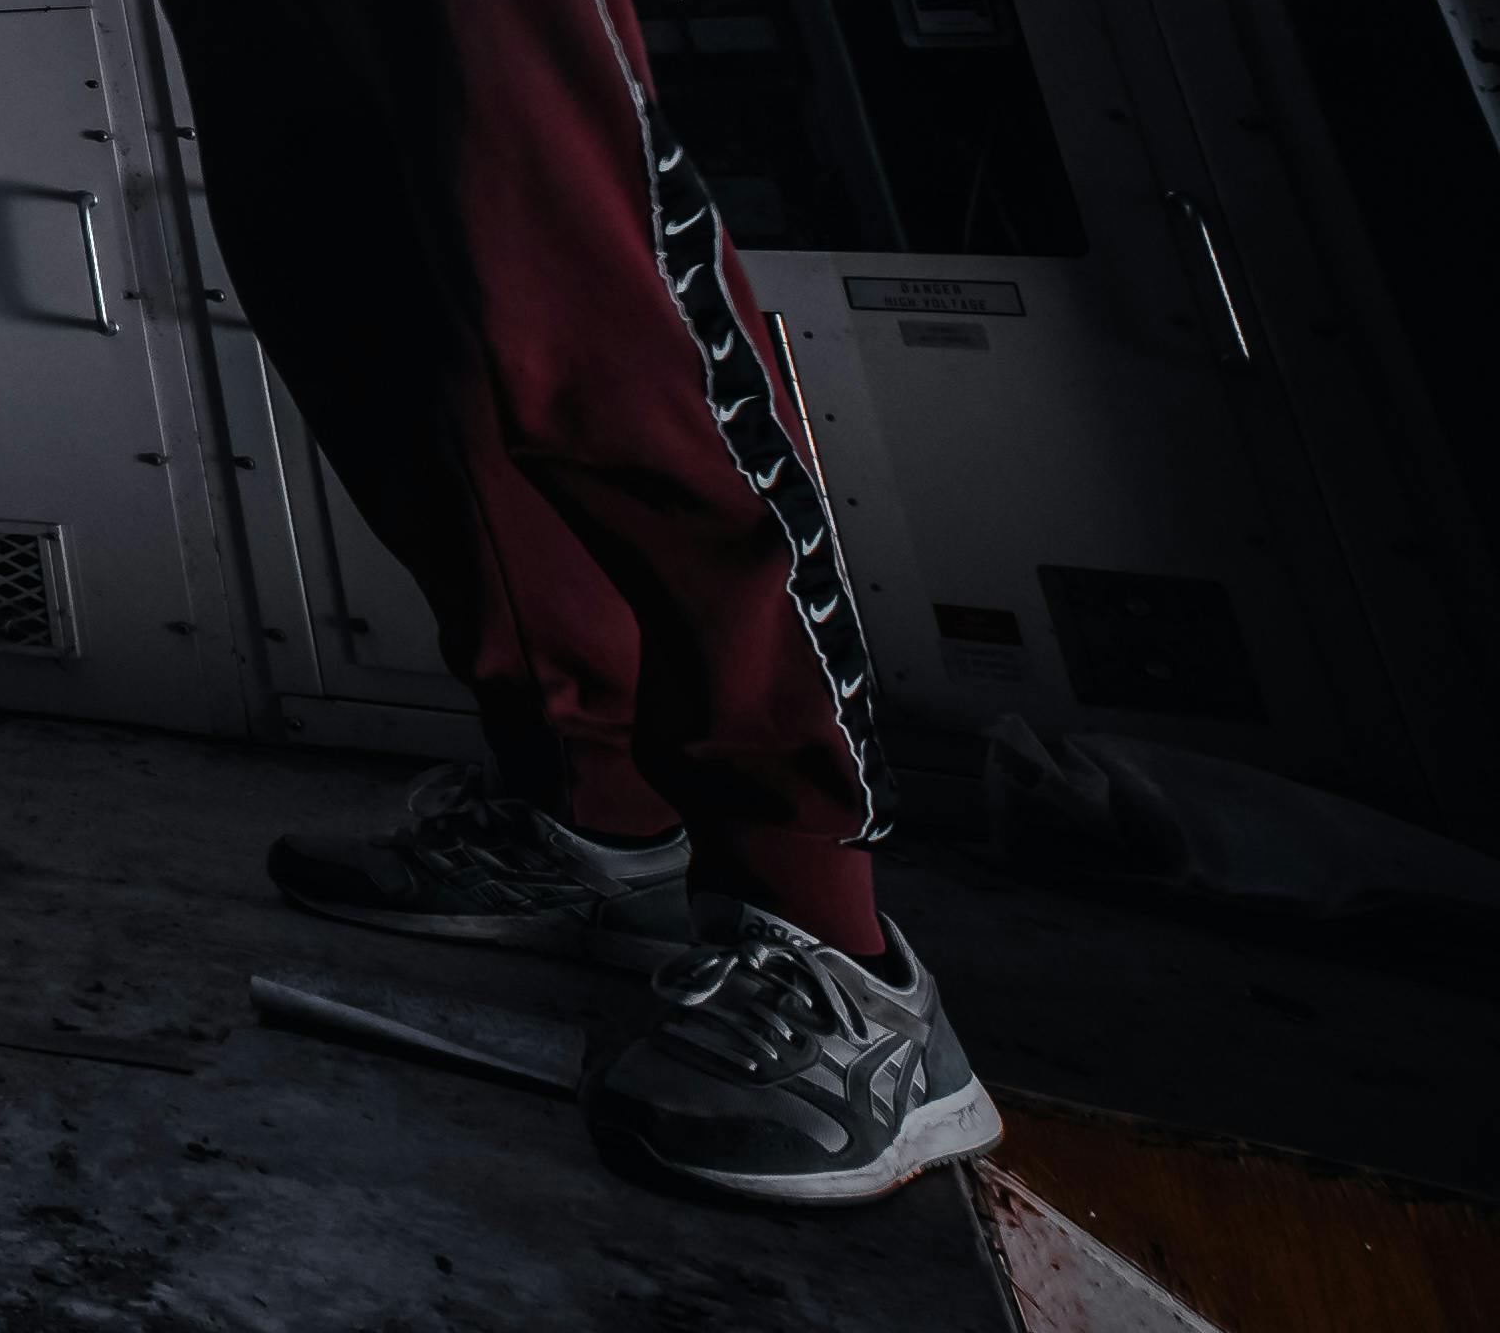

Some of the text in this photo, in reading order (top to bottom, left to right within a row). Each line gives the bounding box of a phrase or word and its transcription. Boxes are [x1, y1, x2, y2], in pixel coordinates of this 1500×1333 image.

[900, 283, 963, 295] DANGER
[884, 296, 988, 311] HIGH VOLTAGE
